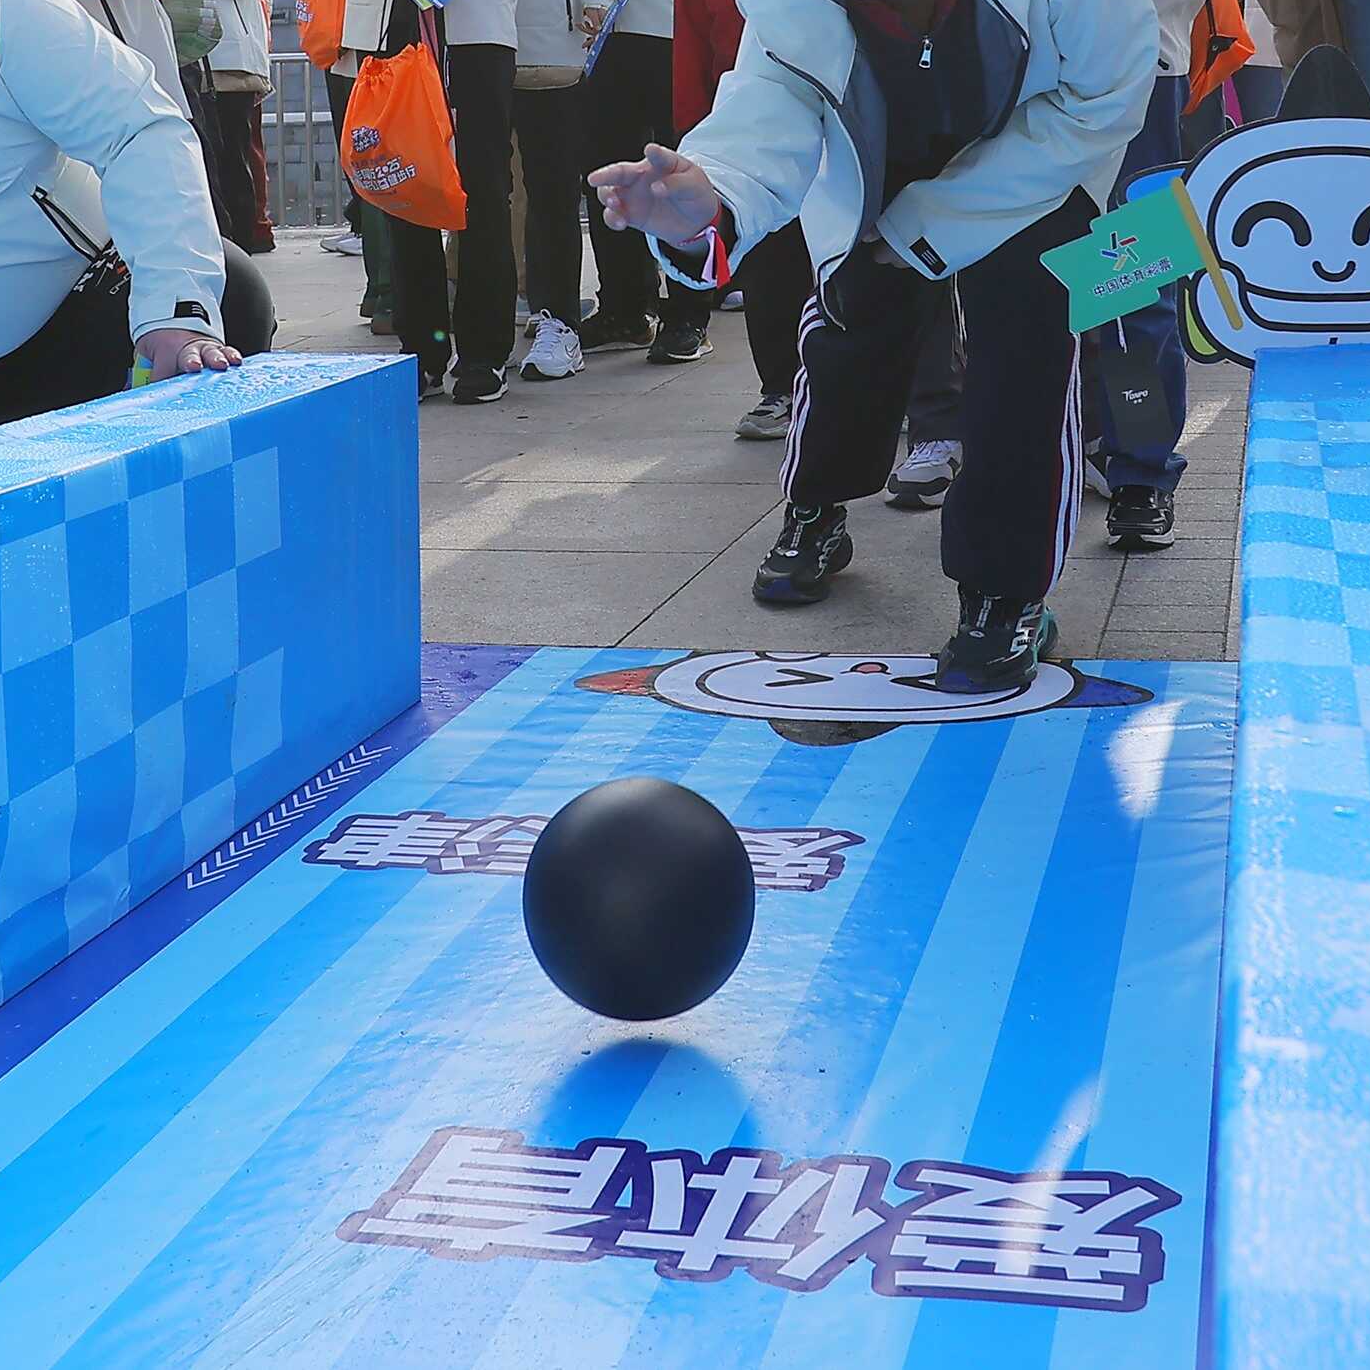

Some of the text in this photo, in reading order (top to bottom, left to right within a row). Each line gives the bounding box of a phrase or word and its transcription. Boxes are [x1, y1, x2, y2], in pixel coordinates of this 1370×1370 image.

[1093, 256, 1173, 297] 中国体育彩票
[358, 1132, 1167, 1303] 爱体育
